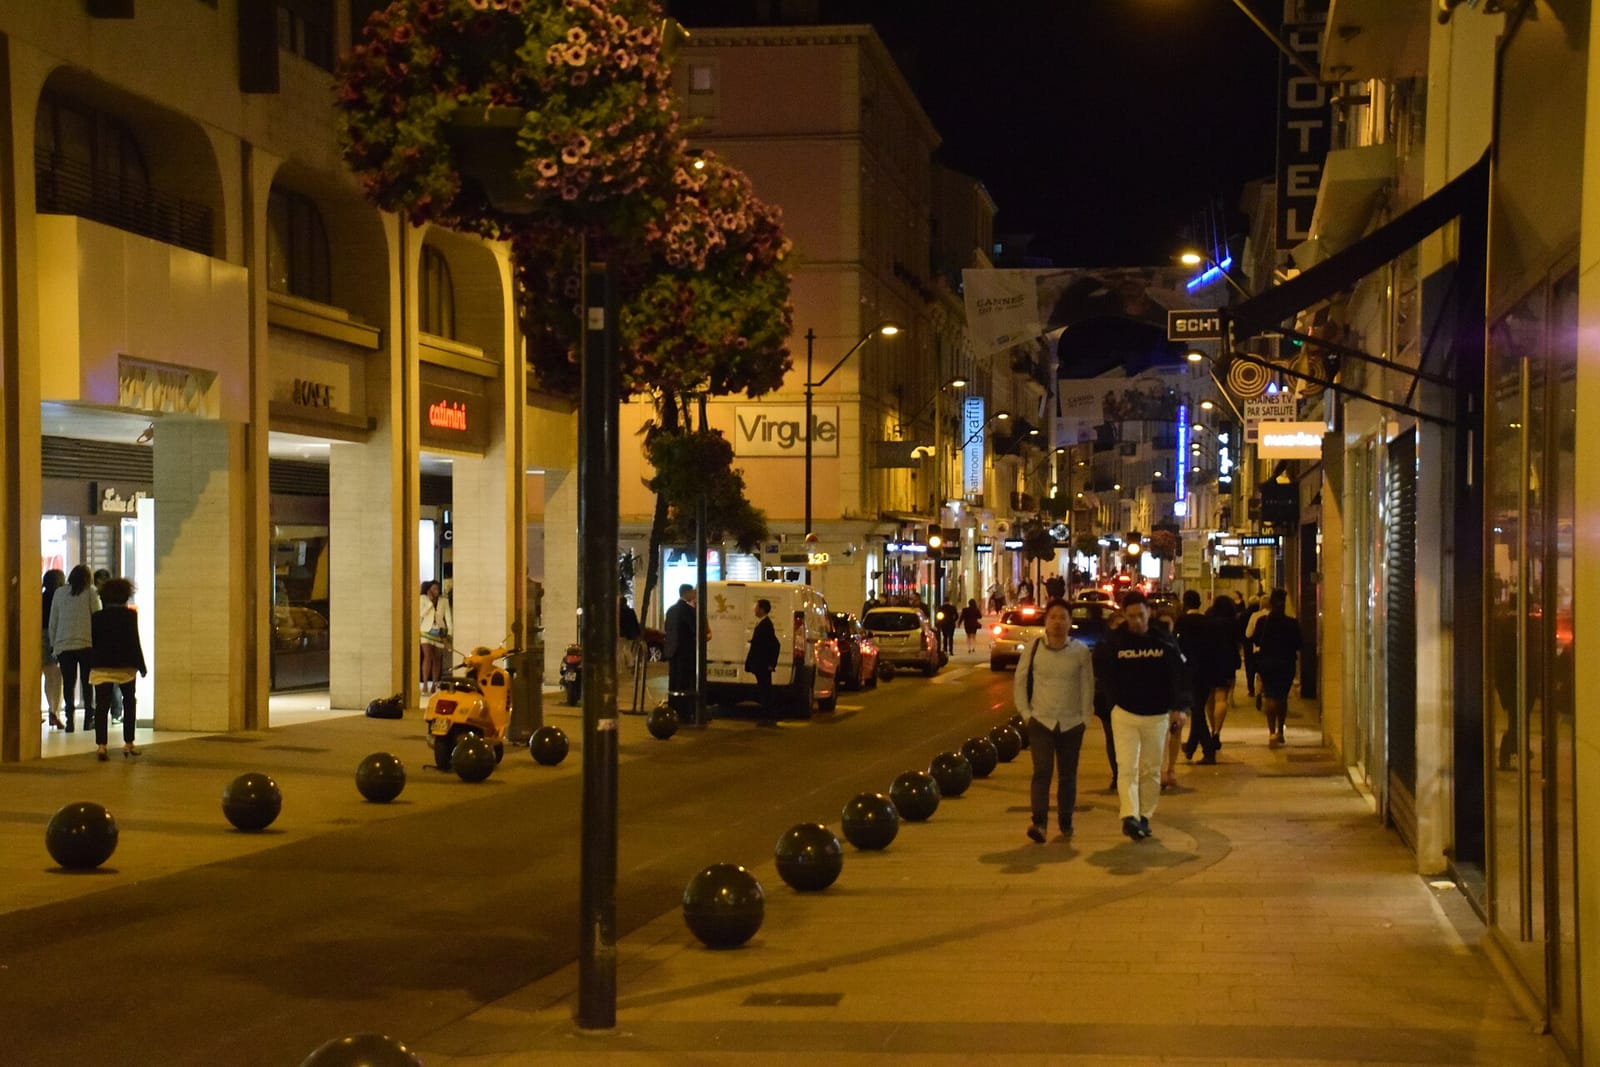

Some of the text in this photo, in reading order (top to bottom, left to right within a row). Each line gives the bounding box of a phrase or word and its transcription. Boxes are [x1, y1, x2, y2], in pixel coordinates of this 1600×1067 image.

[1247, 405, 1293, 416] PAR SATELLITE
[738, 414, 837, 447] Virgule
[970, 447, 979, 494] bathroom
